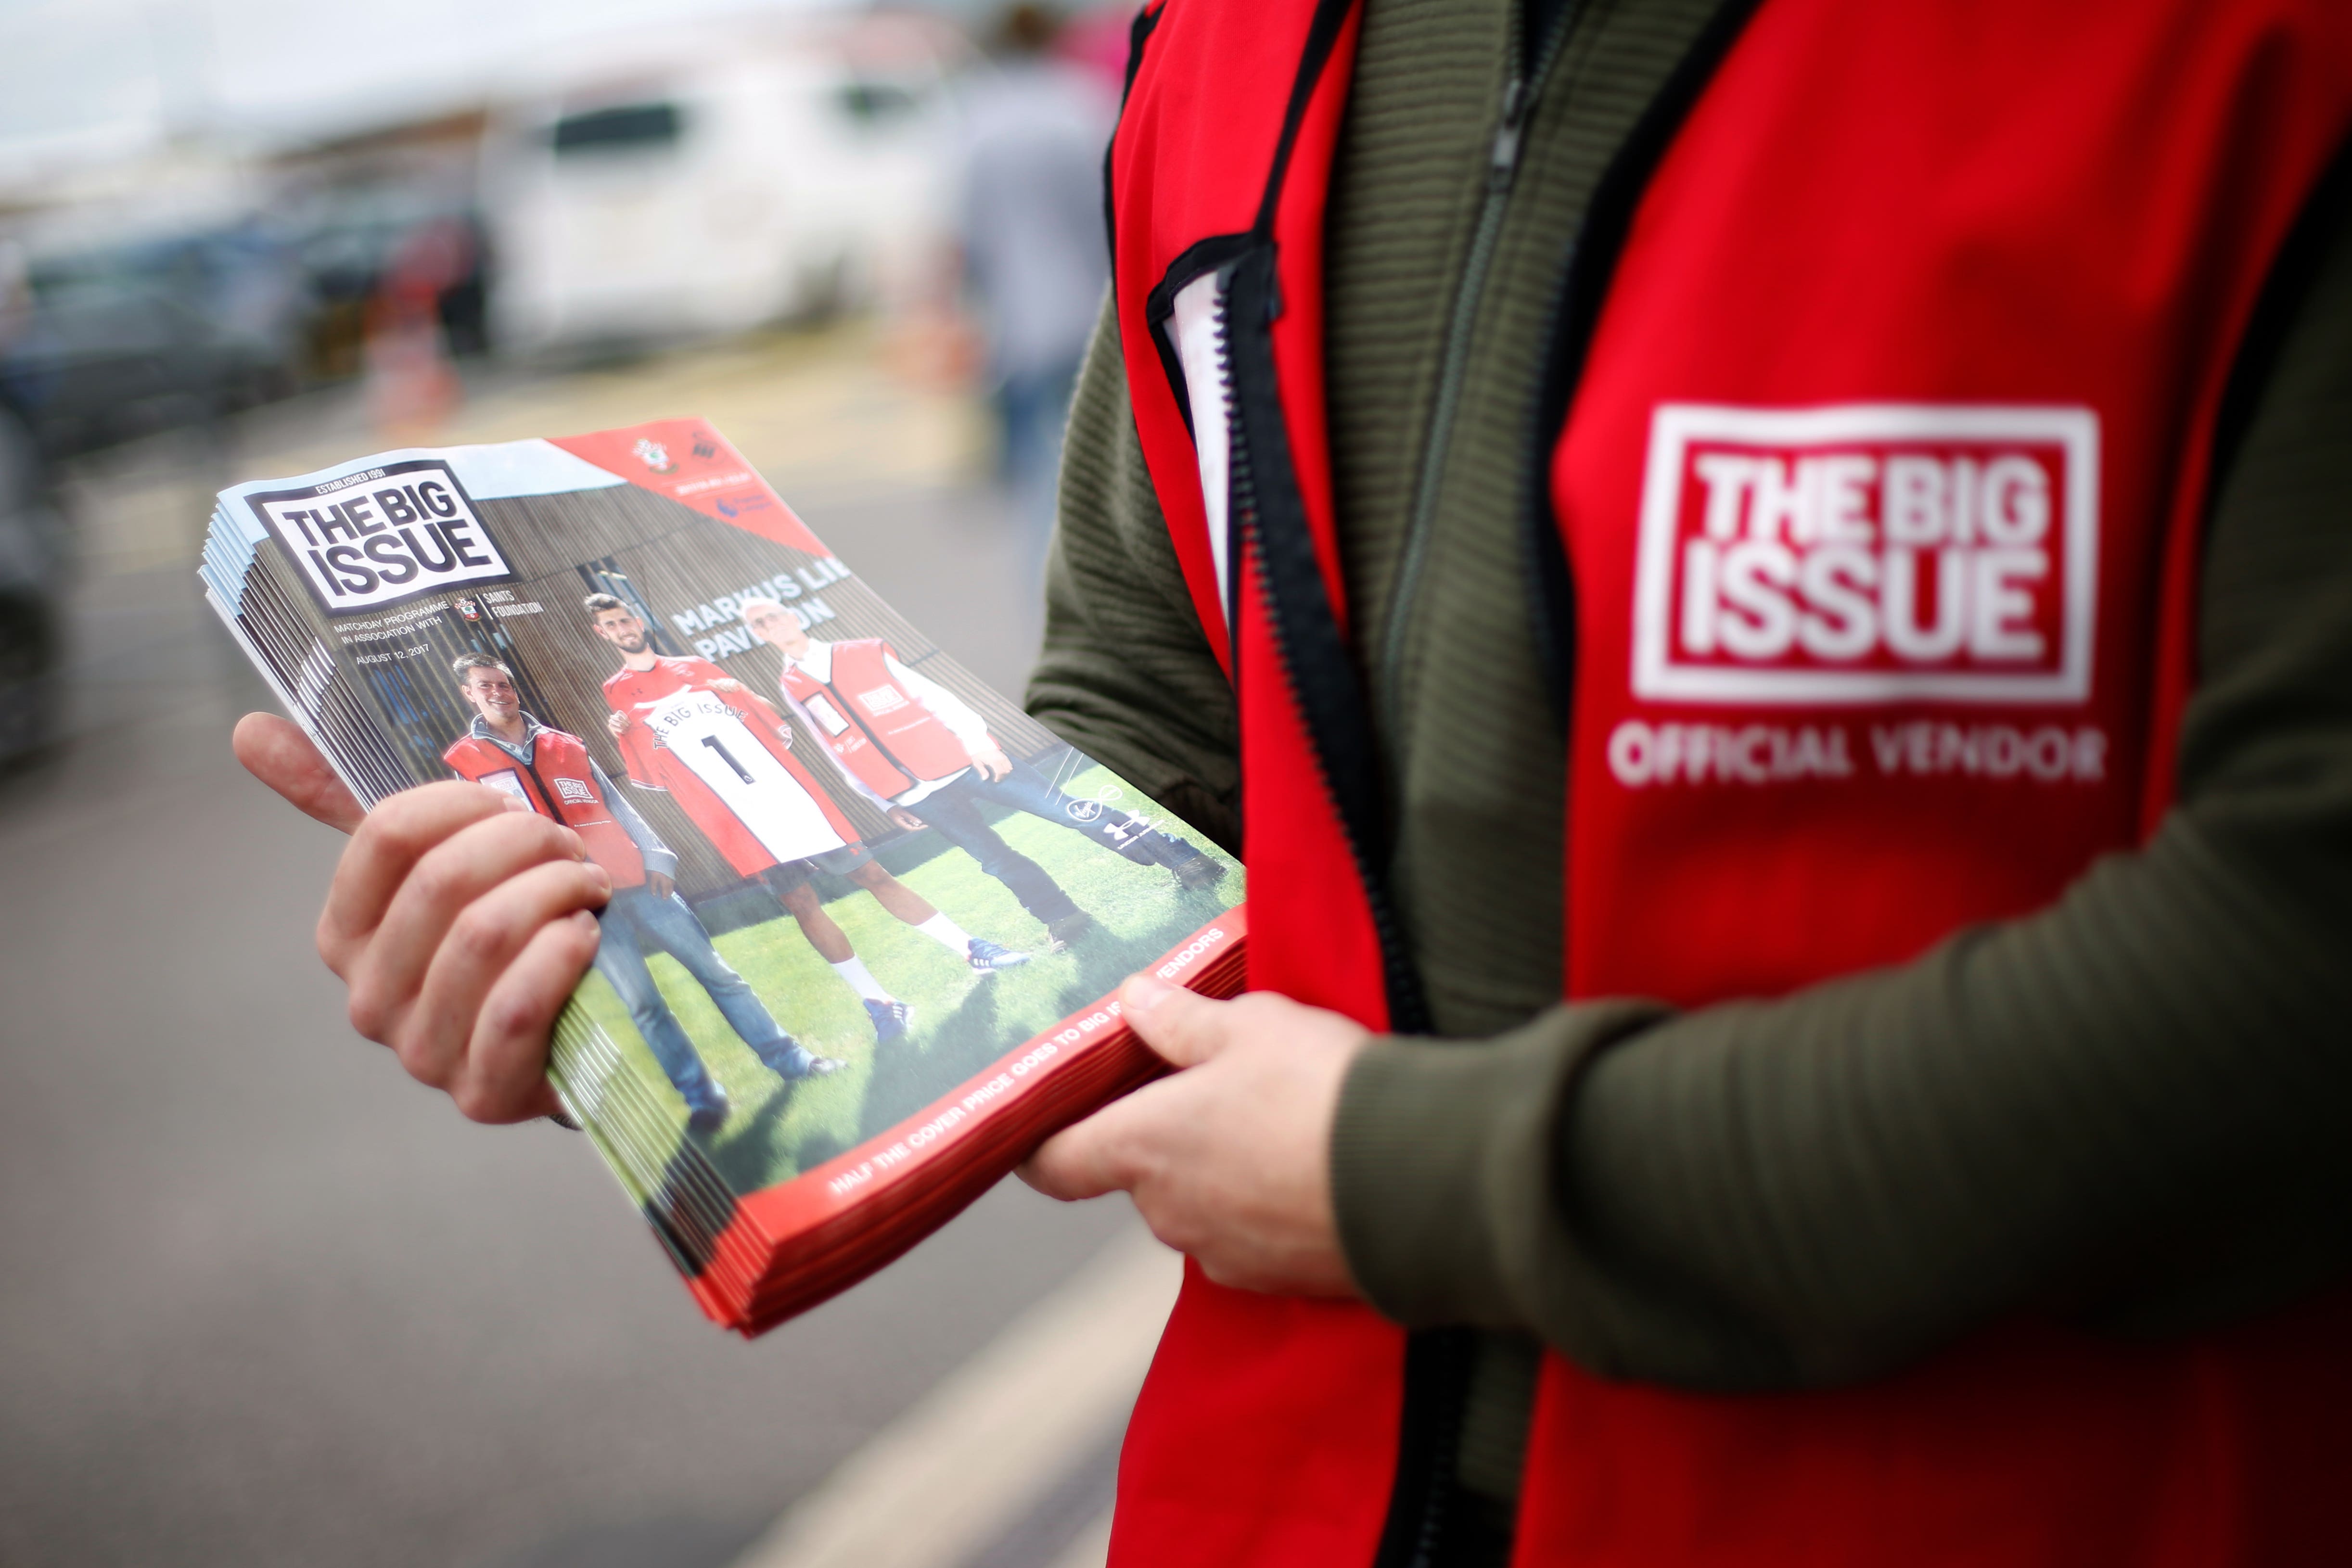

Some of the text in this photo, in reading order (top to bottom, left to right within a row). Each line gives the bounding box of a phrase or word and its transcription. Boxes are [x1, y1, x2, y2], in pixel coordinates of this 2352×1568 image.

[315, 468, 386, 494] ESTABLISHED 1991
[1693, 452, 2051, 547] THE BIG
[281, 481, 458, 546] THE BIG
[307, 519, 493, 596] ISSUE
[333, 601, 450, 633] MATCHDAY PROGRAMME
[483, 590, 515, 604] SAINTS
[491, 601, 544, 618] FOUNDATION
[1681, 536, 2050, 662] ISSUE
[341, 616, 443, 645] IN ASSOCIATION WITH
[357, 644, 430, 664] AUGUST 12, 2017
[653, 702, 749, 750] THE BIG ISSUE
[701, 734, 756, 785] 1
[1608, 718, 2109, 787] OFFICIAL VENDOR
[562, 787, 588, 796] ISSUE
[1074, 801, 1096, 818] Virgin
[828, 928, 1224, 1195] HALF THE COVER PRICE GOES TO BIG ENDORS
